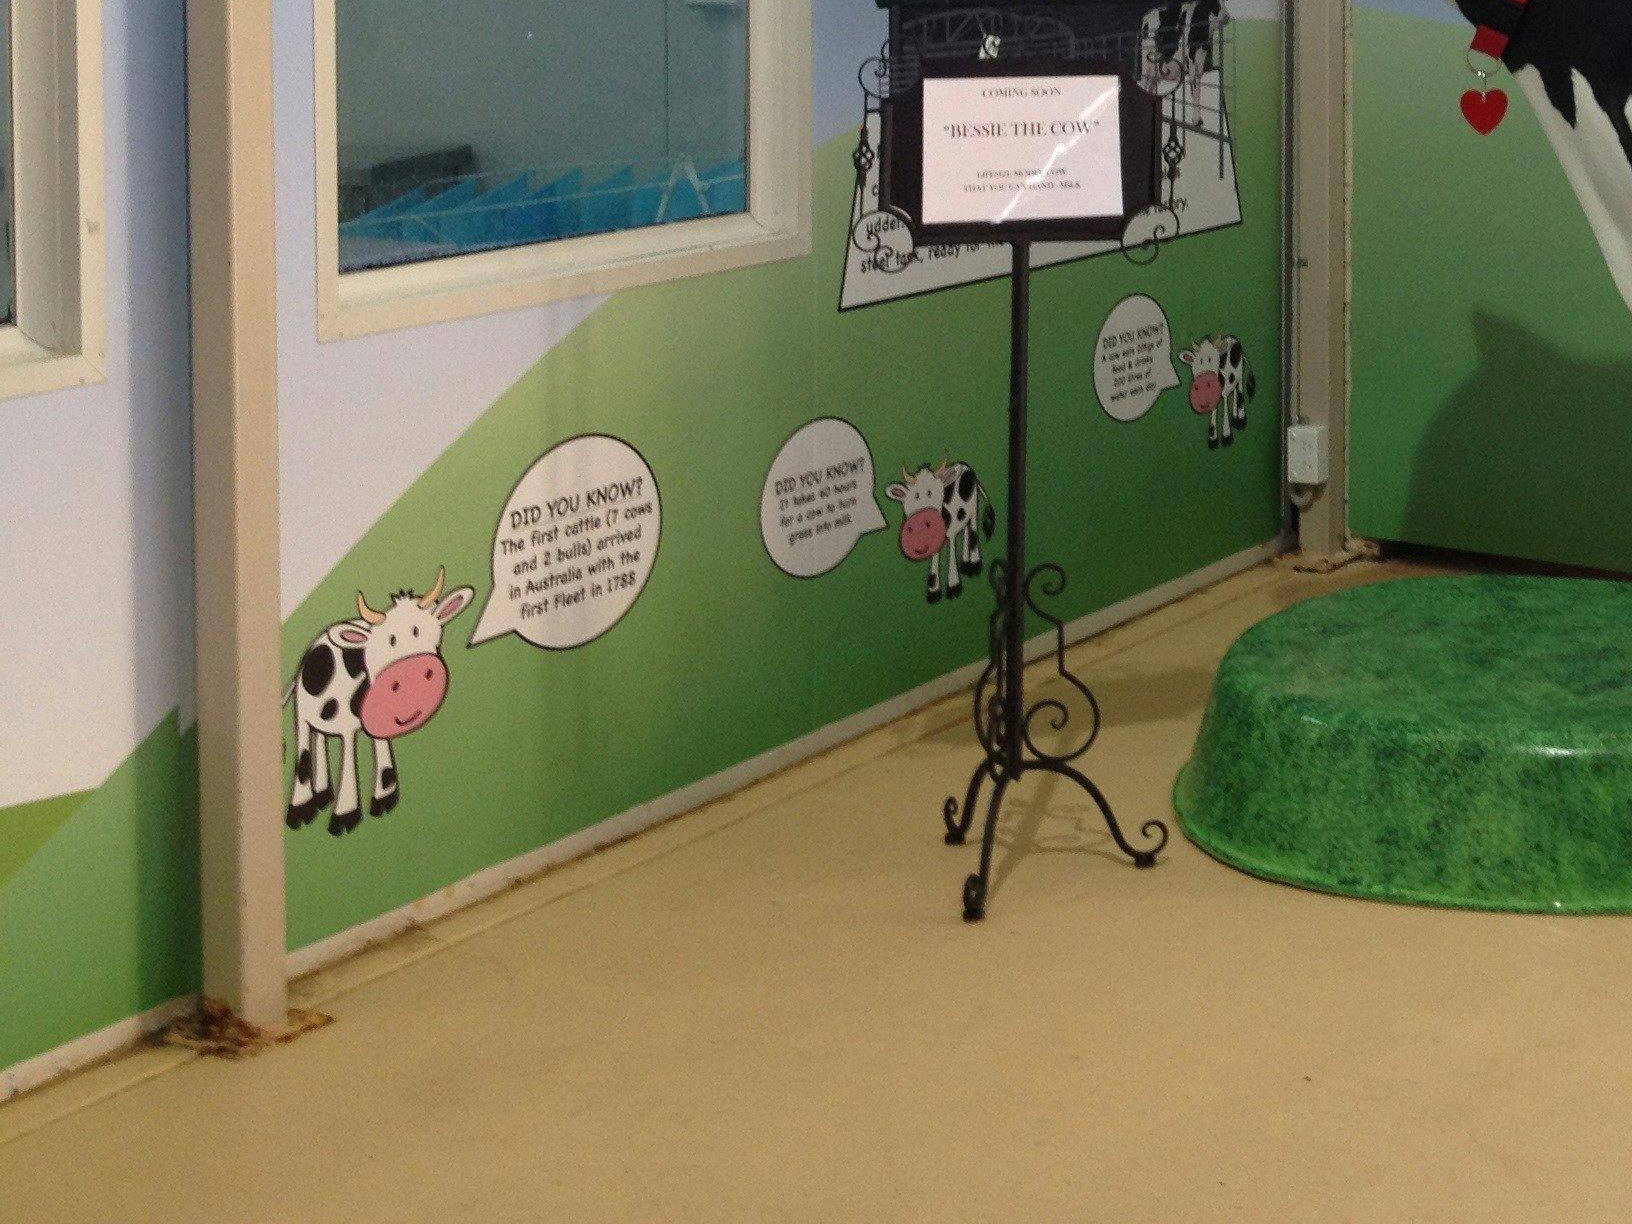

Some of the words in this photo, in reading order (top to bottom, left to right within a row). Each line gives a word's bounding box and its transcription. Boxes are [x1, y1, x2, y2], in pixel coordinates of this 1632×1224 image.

[982, 88, 1028, 98] COMING
[1031, 86, 1062, 97] SOON
[1013, 121, 1047, 137] THE
[510, 505, 541, 529] DID
[546, 493, 579, 518] YOU
[586, 475, 642, 508] KNOW?
[500, 538, 524, 554] The
[530, 524, 558, 546] first
[564, 515, 600, 537] cattle
[624, 501, 652, 520] cows
[513, 555, 537, 575] and
[556, 537, 591, 562] bulls)
[596, 523, 641, 551] arrived
[509, 585, 520, 599] in
[526, 566, 582, 594] Australia
[587, 556, 614, 575] with
[620, 550, 639, 565] the
[521, 598, 549, 619] first
[590, 582, 602, 597] in
[607, 570, 635, 593] 1788
